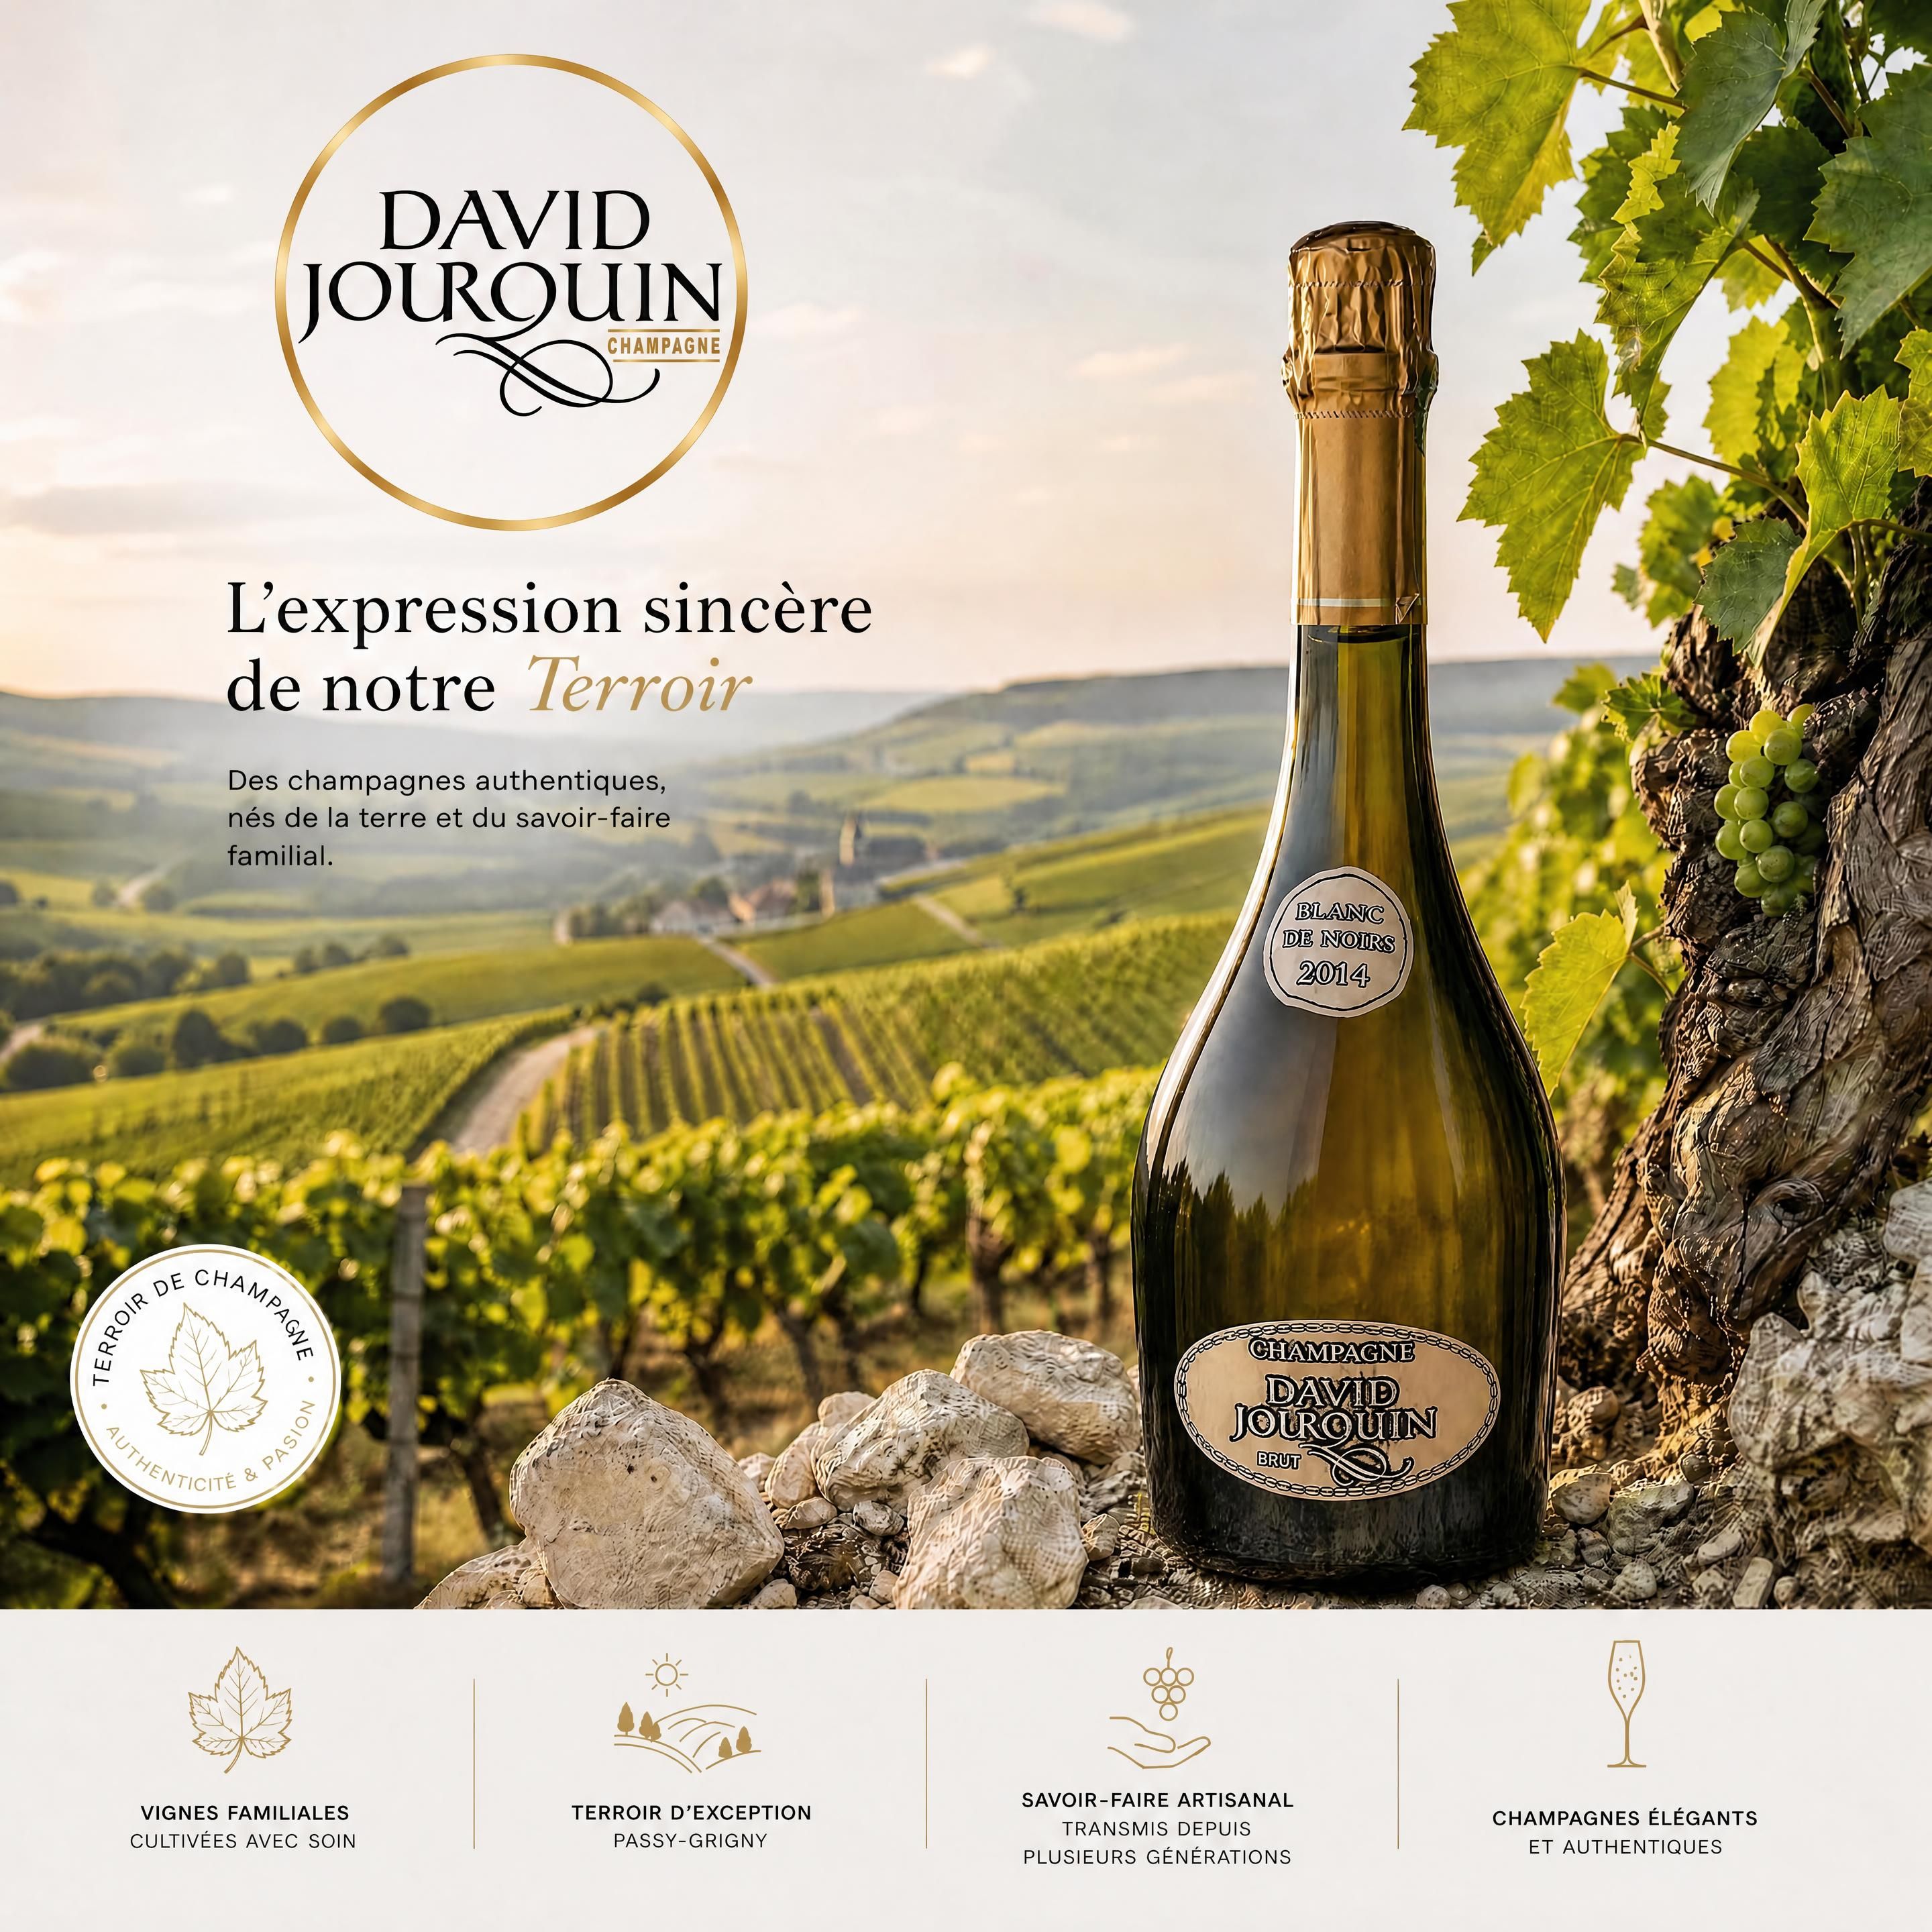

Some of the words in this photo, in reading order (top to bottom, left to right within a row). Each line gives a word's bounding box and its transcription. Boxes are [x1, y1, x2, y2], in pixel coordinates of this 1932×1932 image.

[1295, 902, 1385, 924] BLANC
[1283, 930, 1313, 948] DE
[1321, 930, 1395, 953] NOIRS
[1296, 961, 1371, 987] 2014
[1249, 1338, 1415, 1362] CHAMPAGNE
[1265, 1375, 1400, 1408] DAVID
[1230, 1405, 1438, 1486] JOURQUIN
[1257, 1451, 1302, 1469] BRUT
